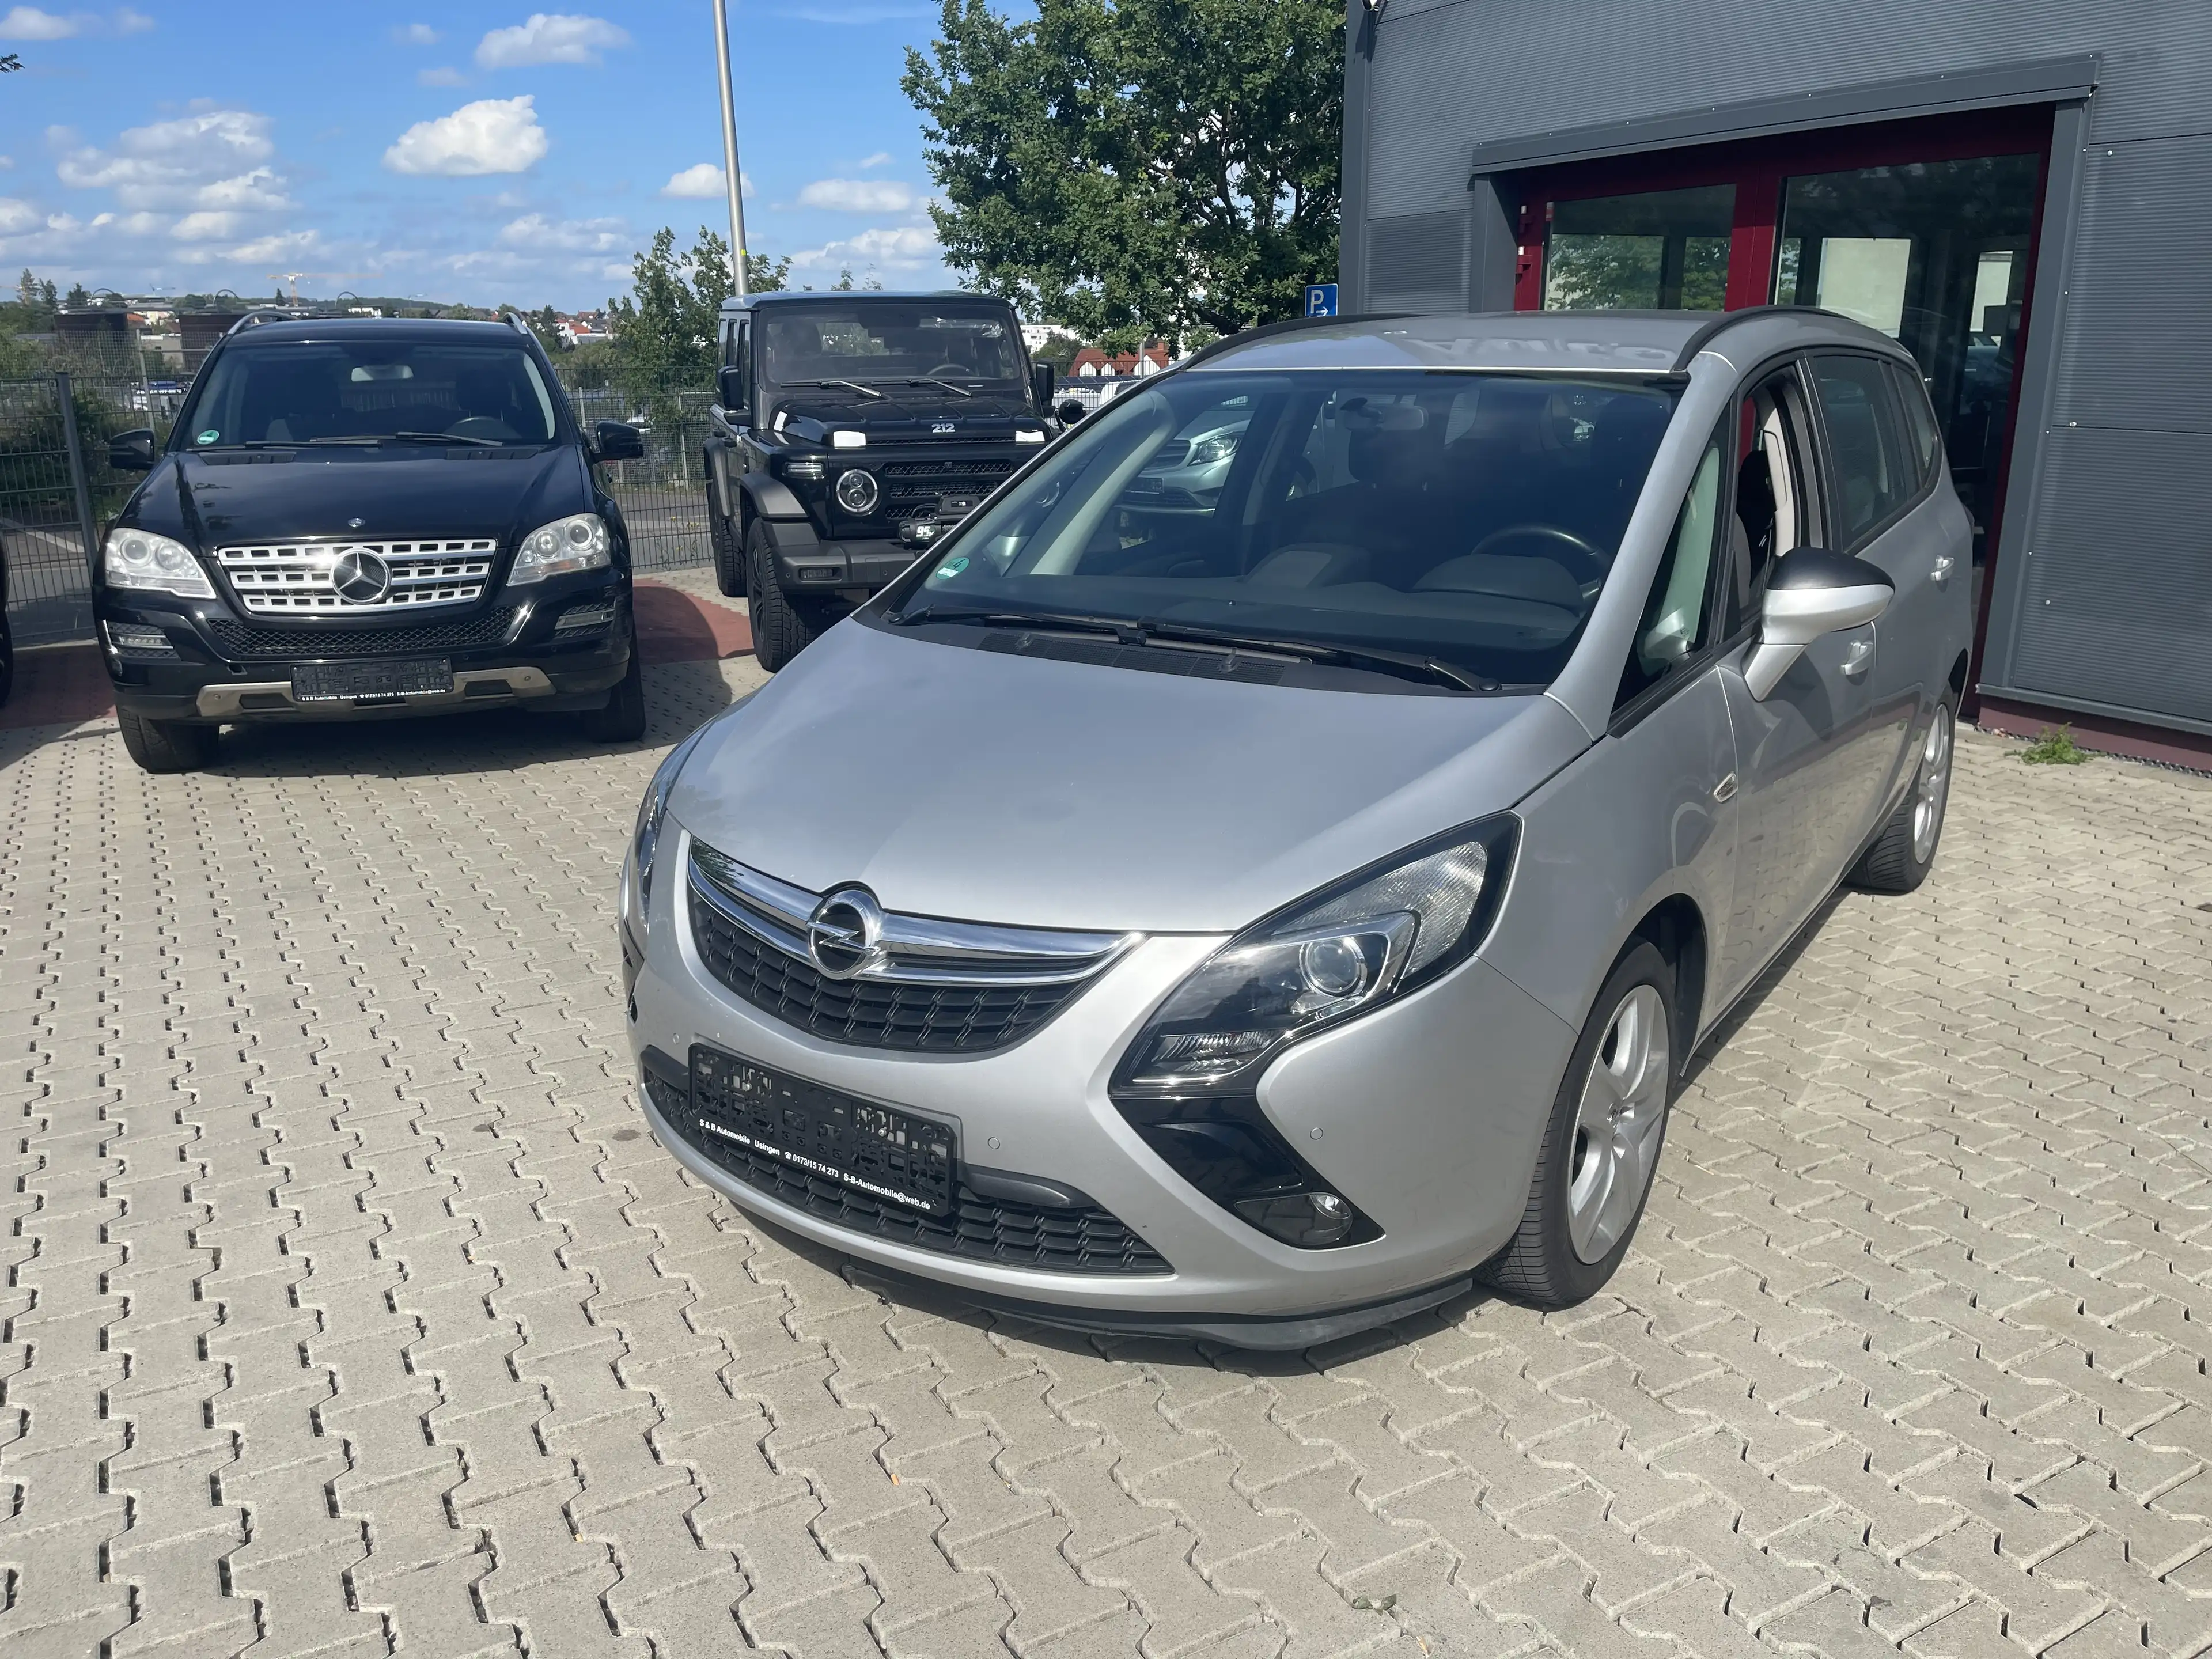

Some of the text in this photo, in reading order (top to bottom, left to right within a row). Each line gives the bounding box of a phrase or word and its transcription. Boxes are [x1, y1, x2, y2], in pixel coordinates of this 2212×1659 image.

[1310, 290, 1324, 313] P
[931, 423, 956, 433] 212
[699, 1119, 704, 1127] S
[705, 1121, 710, 1129] &
[717, 1126, 750, 1144] Automobile
[754, 1139, 780, 1156] Usingen
[793, 1154, 817, 1169] 0173/15
[817, 1163, 826, 1173] 74
[827, 1167, 839, 1178] 273
[843, 1173, 931, 1210] S-B-Automobile@web.de
